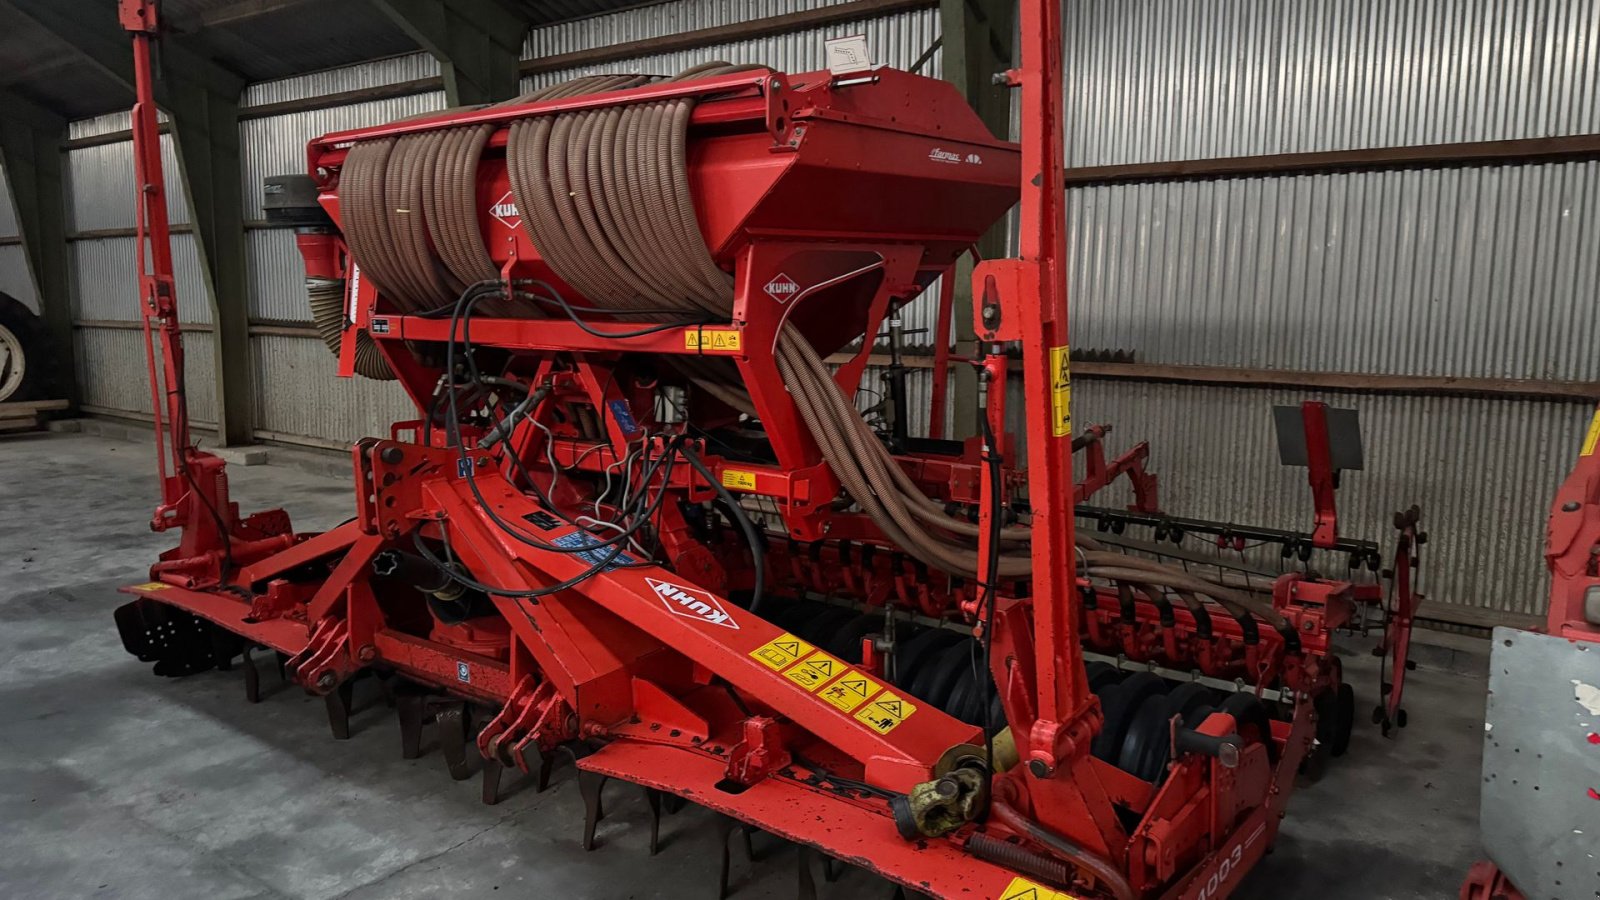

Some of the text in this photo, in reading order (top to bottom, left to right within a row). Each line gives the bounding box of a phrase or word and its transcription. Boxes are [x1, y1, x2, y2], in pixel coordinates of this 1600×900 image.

[495, 203, 519, 217] KUH
[769, 283, 796, 294] KUHN
[654, 582, 729, 624] KUHN
